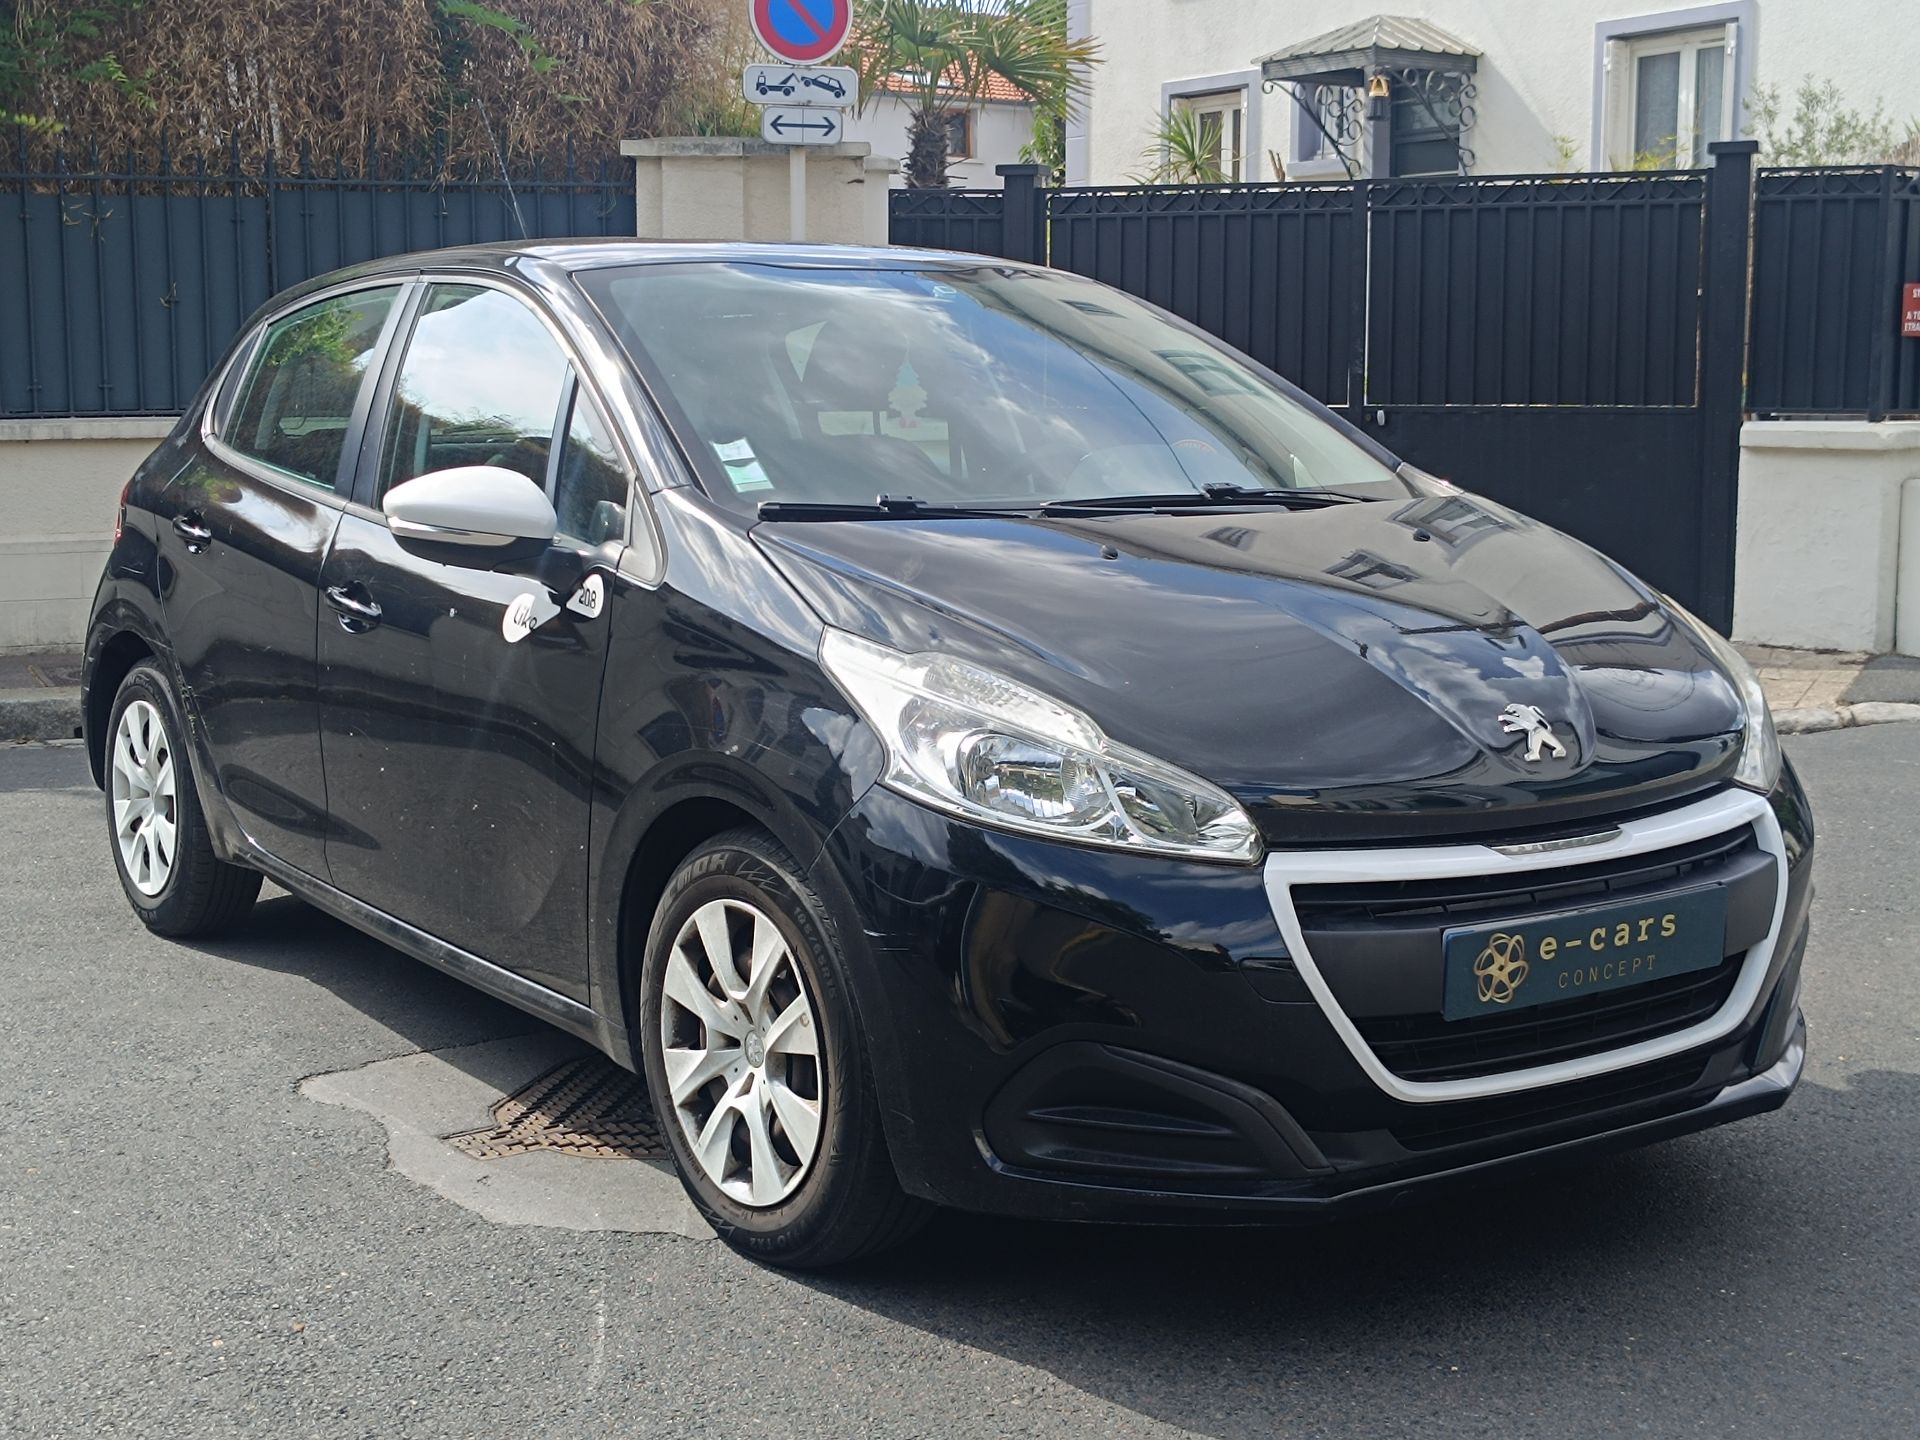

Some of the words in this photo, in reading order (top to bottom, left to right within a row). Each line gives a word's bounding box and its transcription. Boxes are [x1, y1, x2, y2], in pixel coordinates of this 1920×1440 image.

[579, 583, 597, 609] 208
[1540, 913, 1676, 960] e-cars
[1558, 955, 1656, 988] CONCEPT
